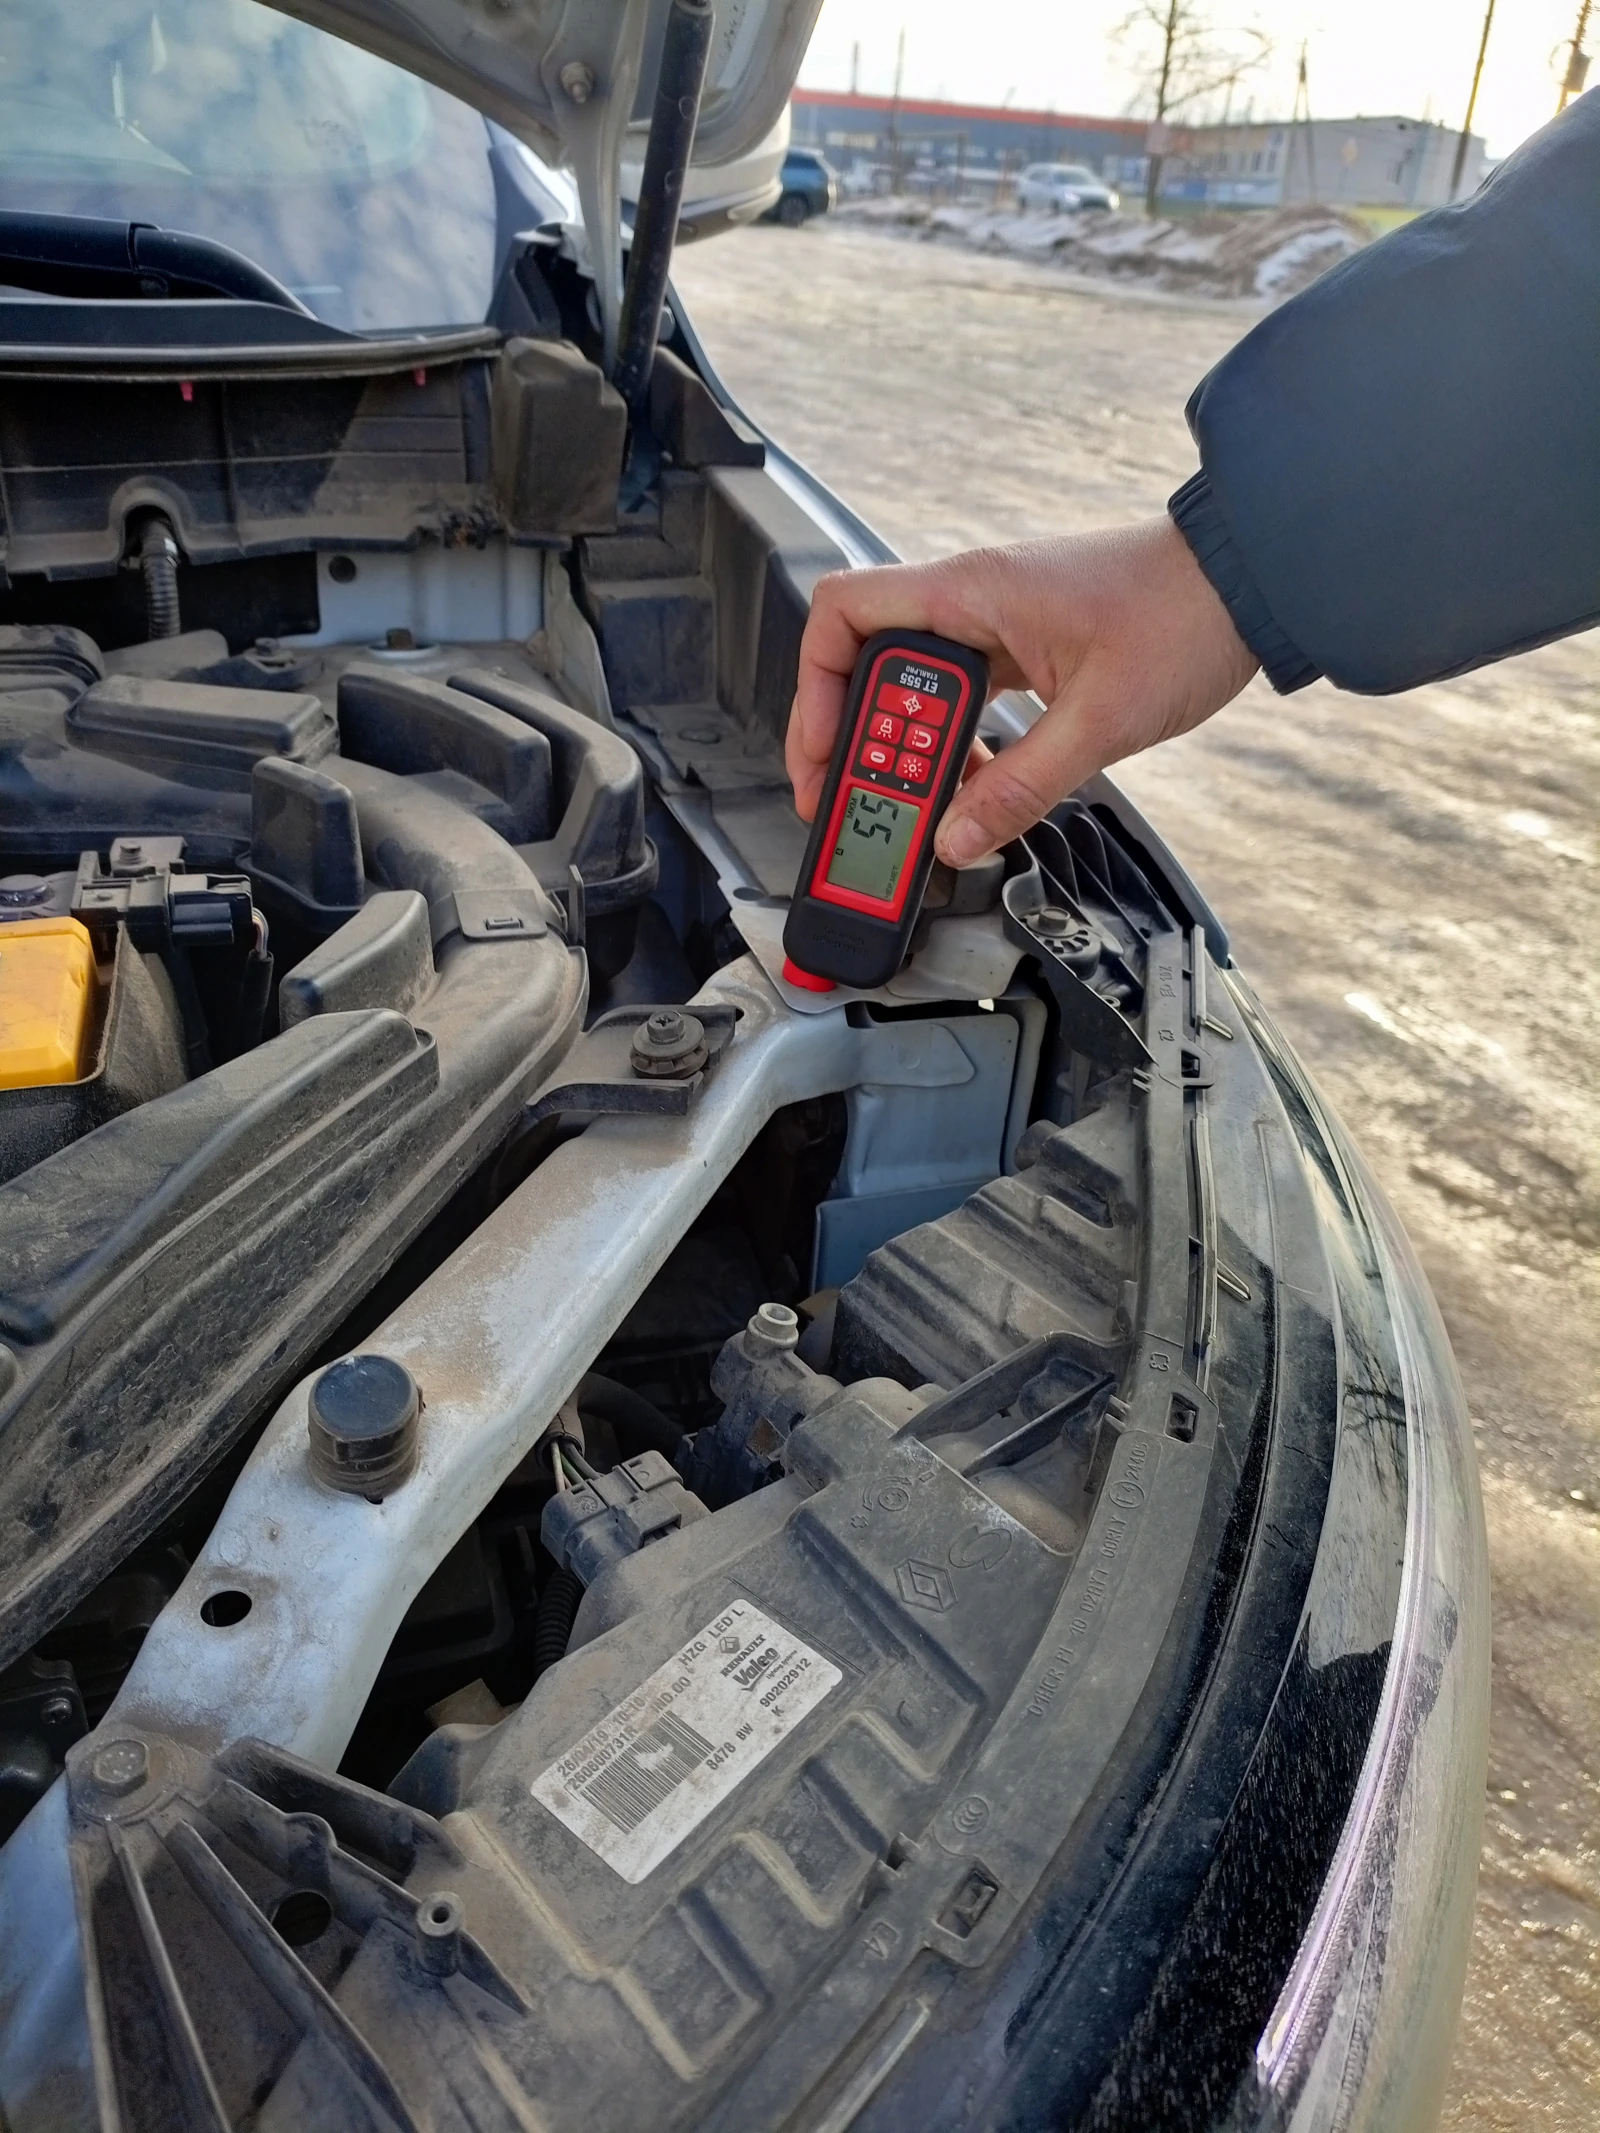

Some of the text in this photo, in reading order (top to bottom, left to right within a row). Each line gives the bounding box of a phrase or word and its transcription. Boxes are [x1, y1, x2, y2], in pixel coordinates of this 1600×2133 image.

[899, 672, 939, 694] ET 555
[853, 794, 899, 845] 55
[1149, 1353, 1170, 1372] C3
[677, 1640, 708, 1668] HZG
[708, 1615, 734, 1640] LED
[732, 1608, 746, 1619] L
[720, 1634, 766, 1677] RENAULT
[732, 1647, 779, 1686] Valeo
[759, 1657, 812, 1708] 90202912
[771, 1705, 785, 1717] K
[705, 1741, 737, 1771] 8478
